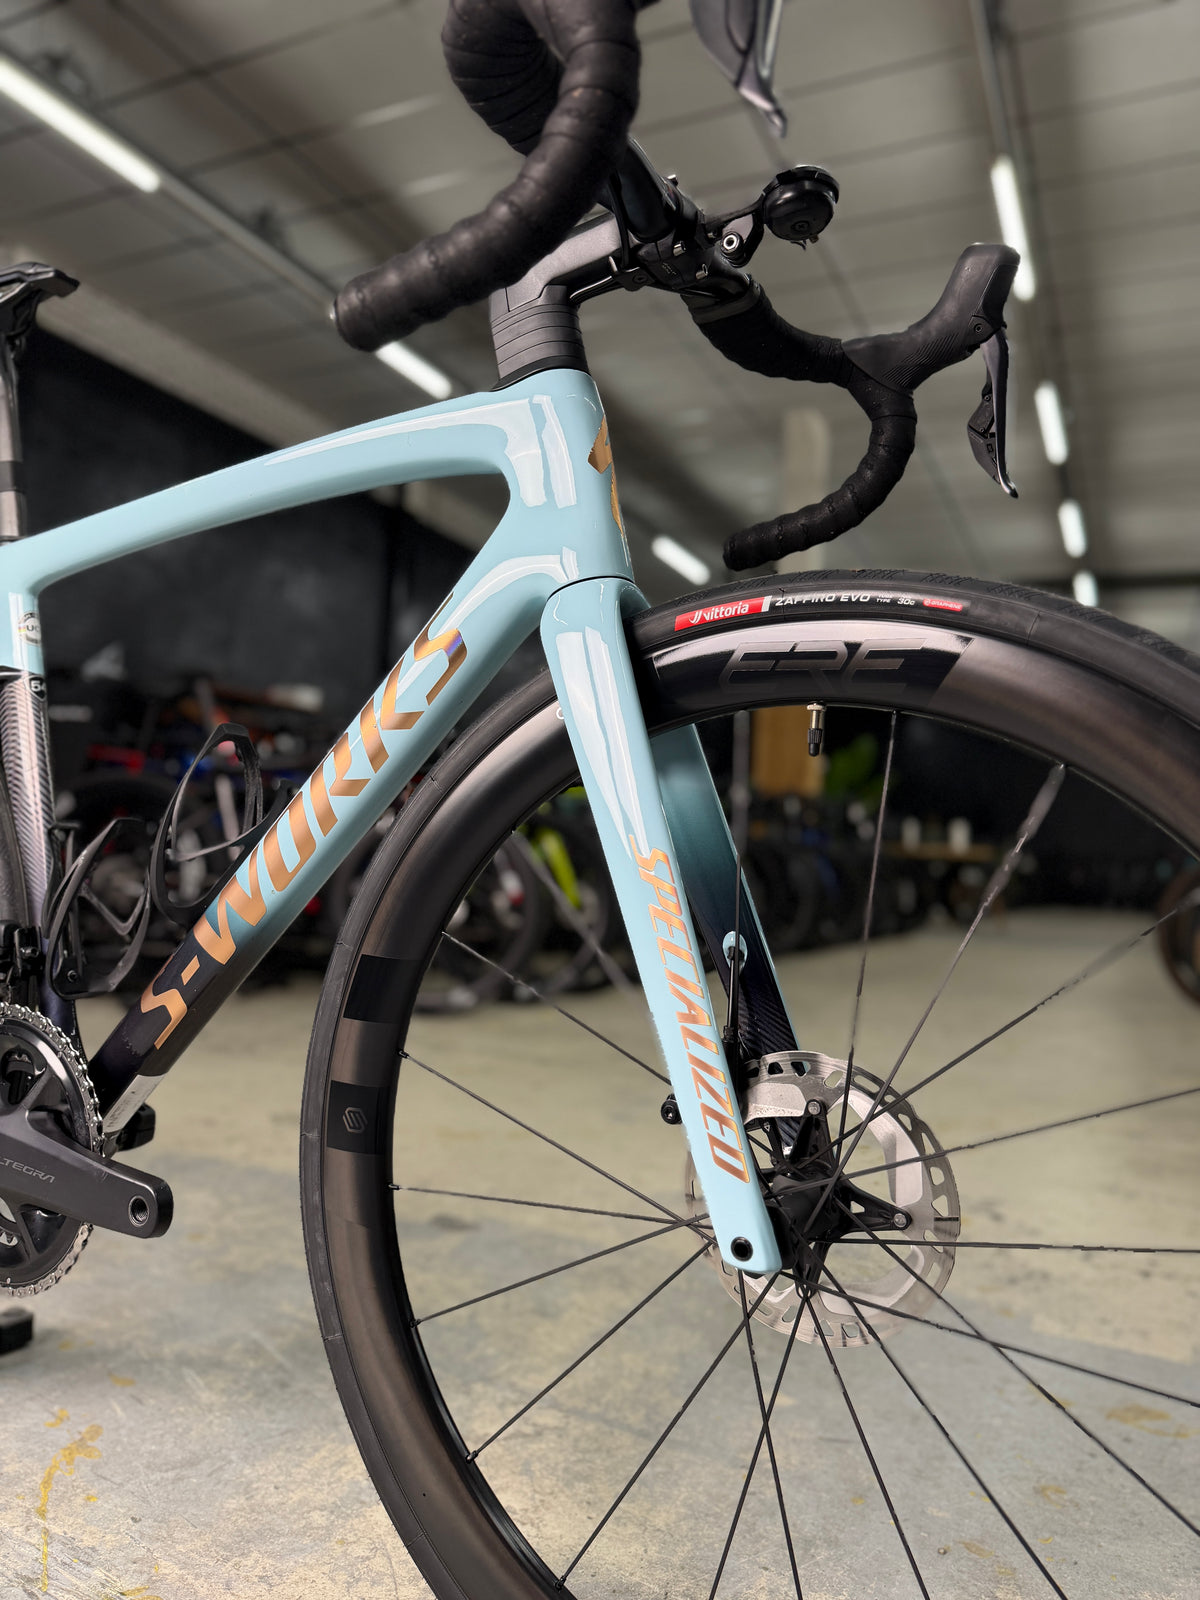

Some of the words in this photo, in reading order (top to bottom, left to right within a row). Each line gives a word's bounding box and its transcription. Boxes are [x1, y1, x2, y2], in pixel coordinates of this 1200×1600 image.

[703, 602, 750, 621] vittoria
[775, 593, 836, 607] ZAFFIRO
[839, 592, 871, 602] EVO
[140, 592, 468, 1050] S-WORKS
[628, 834, 750, 1184] SPECIALIZED
